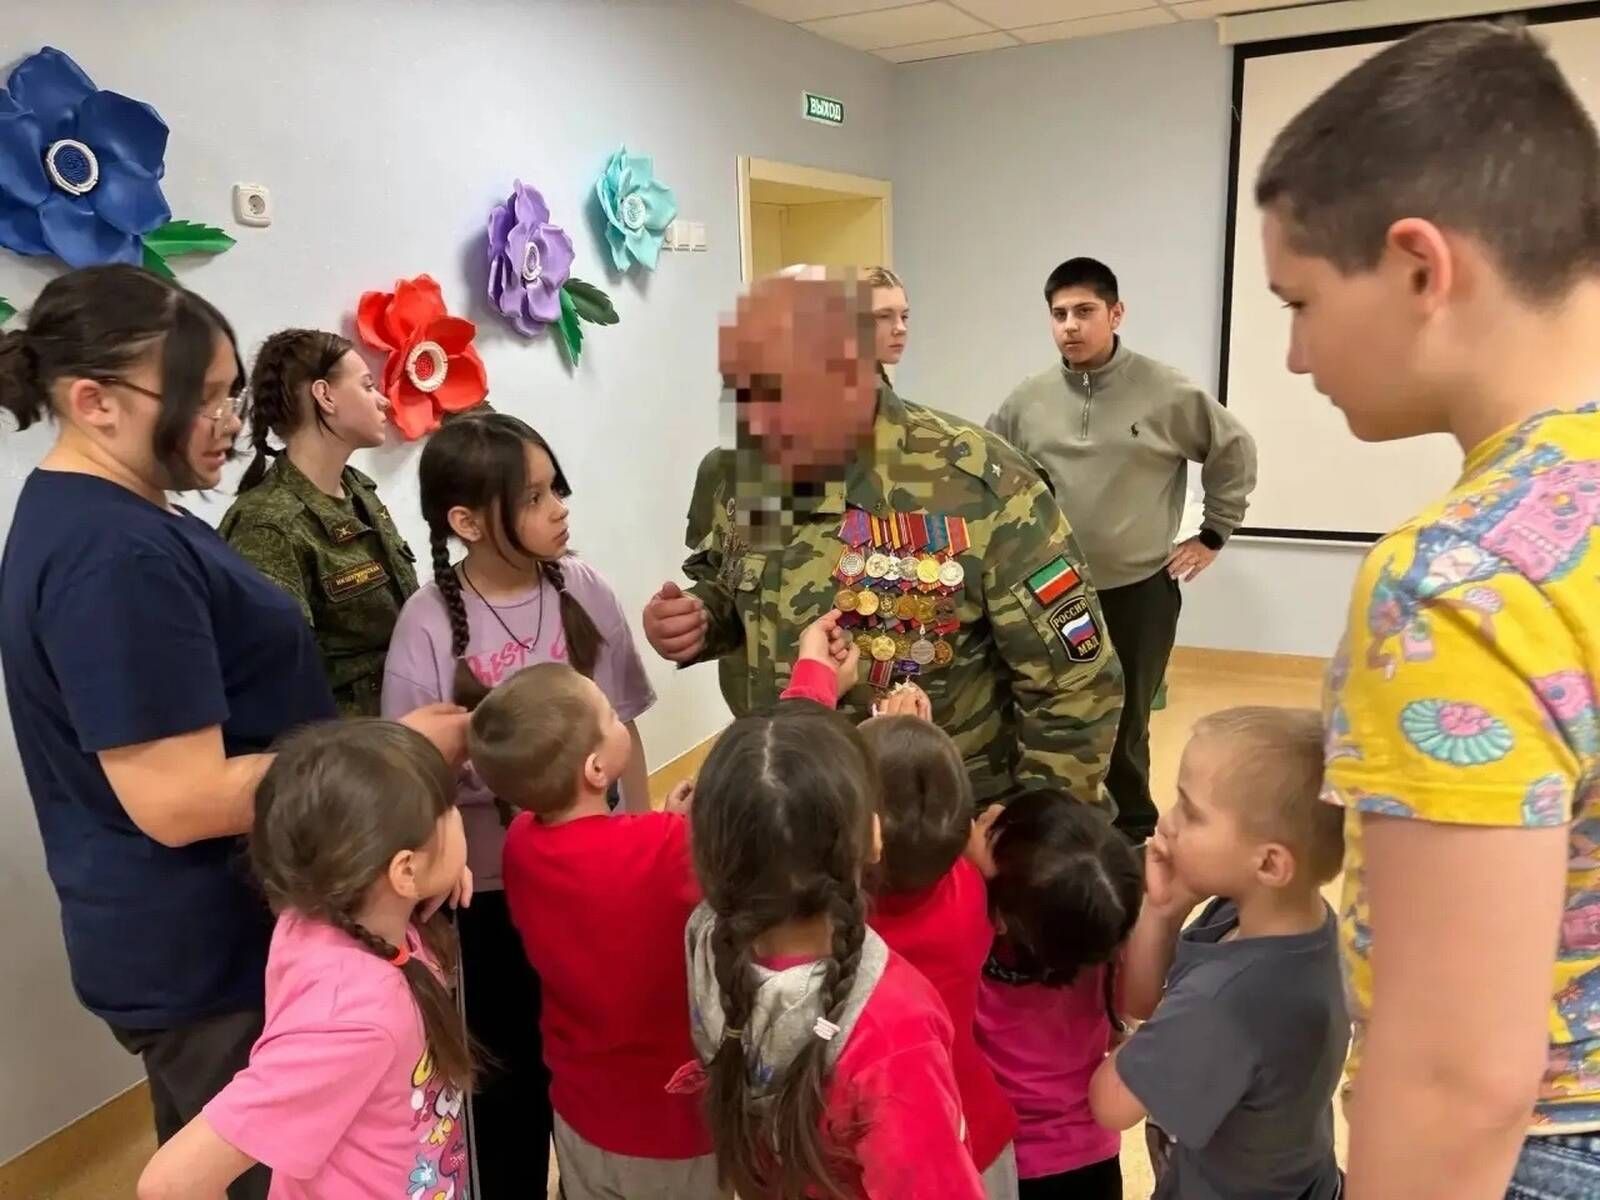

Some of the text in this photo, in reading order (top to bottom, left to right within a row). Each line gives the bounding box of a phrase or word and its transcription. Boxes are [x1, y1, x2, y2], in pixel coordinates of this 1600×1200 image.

[810, 96, 841, 121] ВЫХОД
[1052, 599, 1088, 628] РОССИЯ
[1077, 635, 1099, 656] МВД
